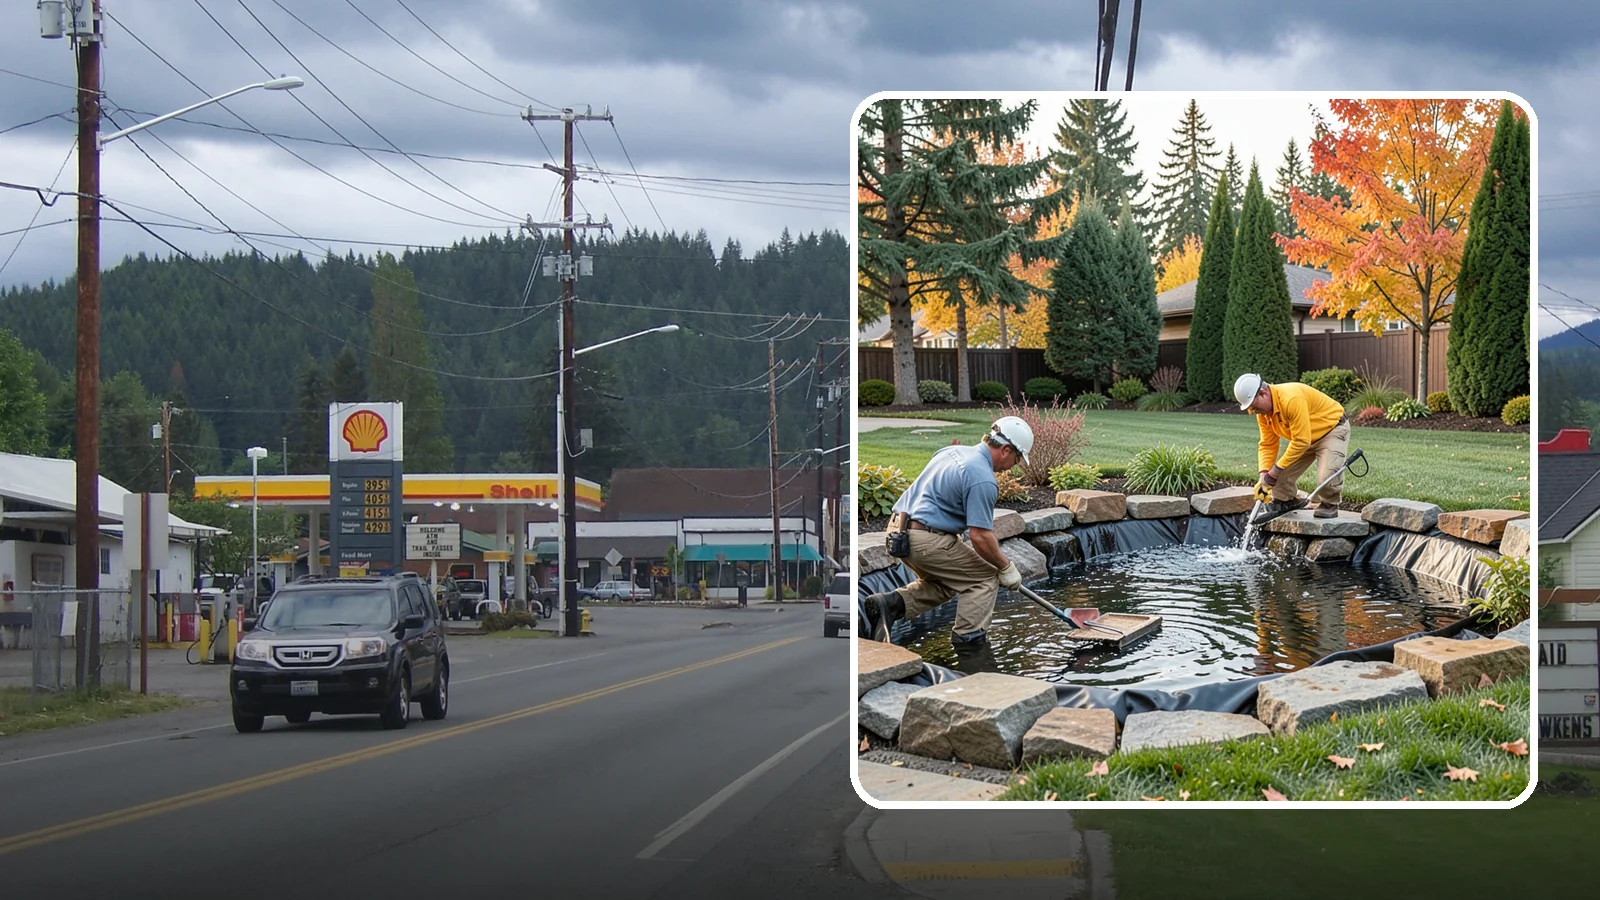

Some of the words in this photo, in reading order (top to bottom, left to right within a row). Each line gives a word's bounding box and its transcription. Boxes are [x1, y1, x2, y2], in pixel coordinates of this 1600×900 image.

[366, 480, 383, 490] 395
[490, 484, 547, 498] Shell
[366, 494, 383, 504] 405
[366, 508, 383, 518] 415
[366, 522, 383, 532] 429
